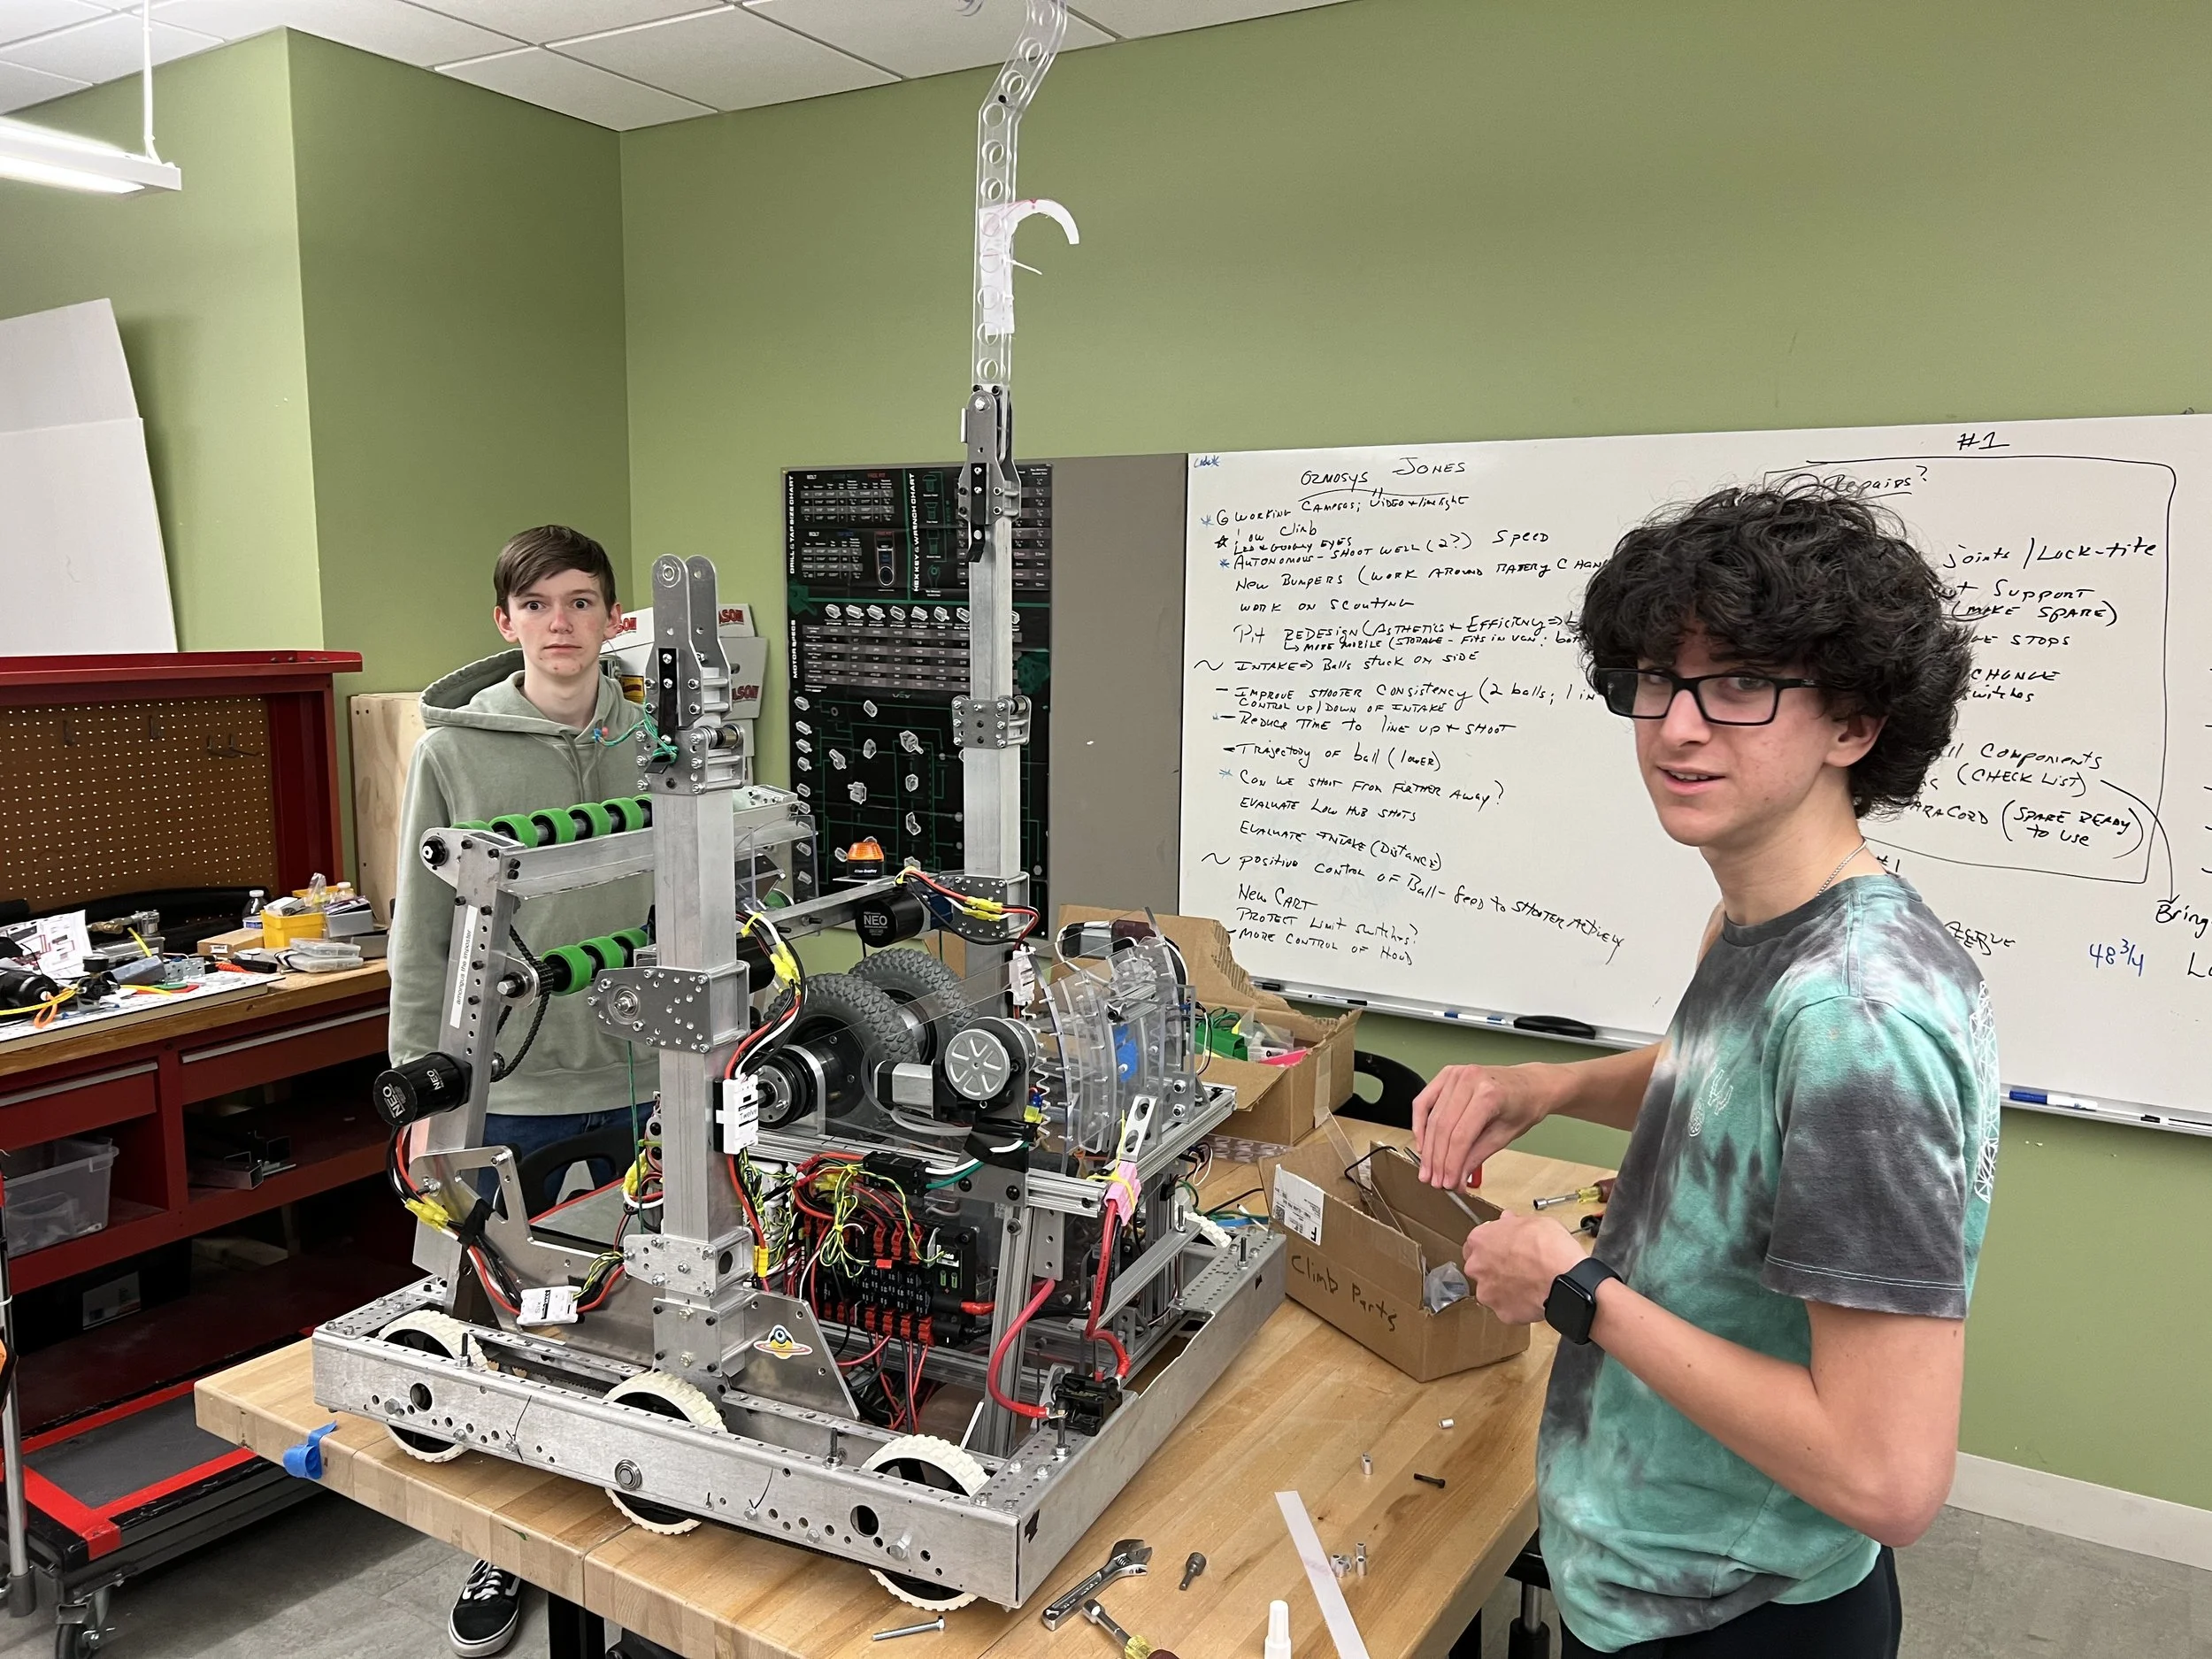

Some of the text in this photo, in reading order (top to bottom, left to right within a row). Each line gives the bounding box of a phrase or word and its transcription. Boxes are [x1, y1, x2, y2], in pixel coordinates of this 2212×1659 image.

[1957, 432, 2010, 450] #1
[1392, 457, 1465, 475] JONES
[864, 915, 887, 926] NEO
[2089, 943, 2116, 968] 48
[426, 1070, 442, 1090] NEO
[383, 1086, 403, 1117] NEO
